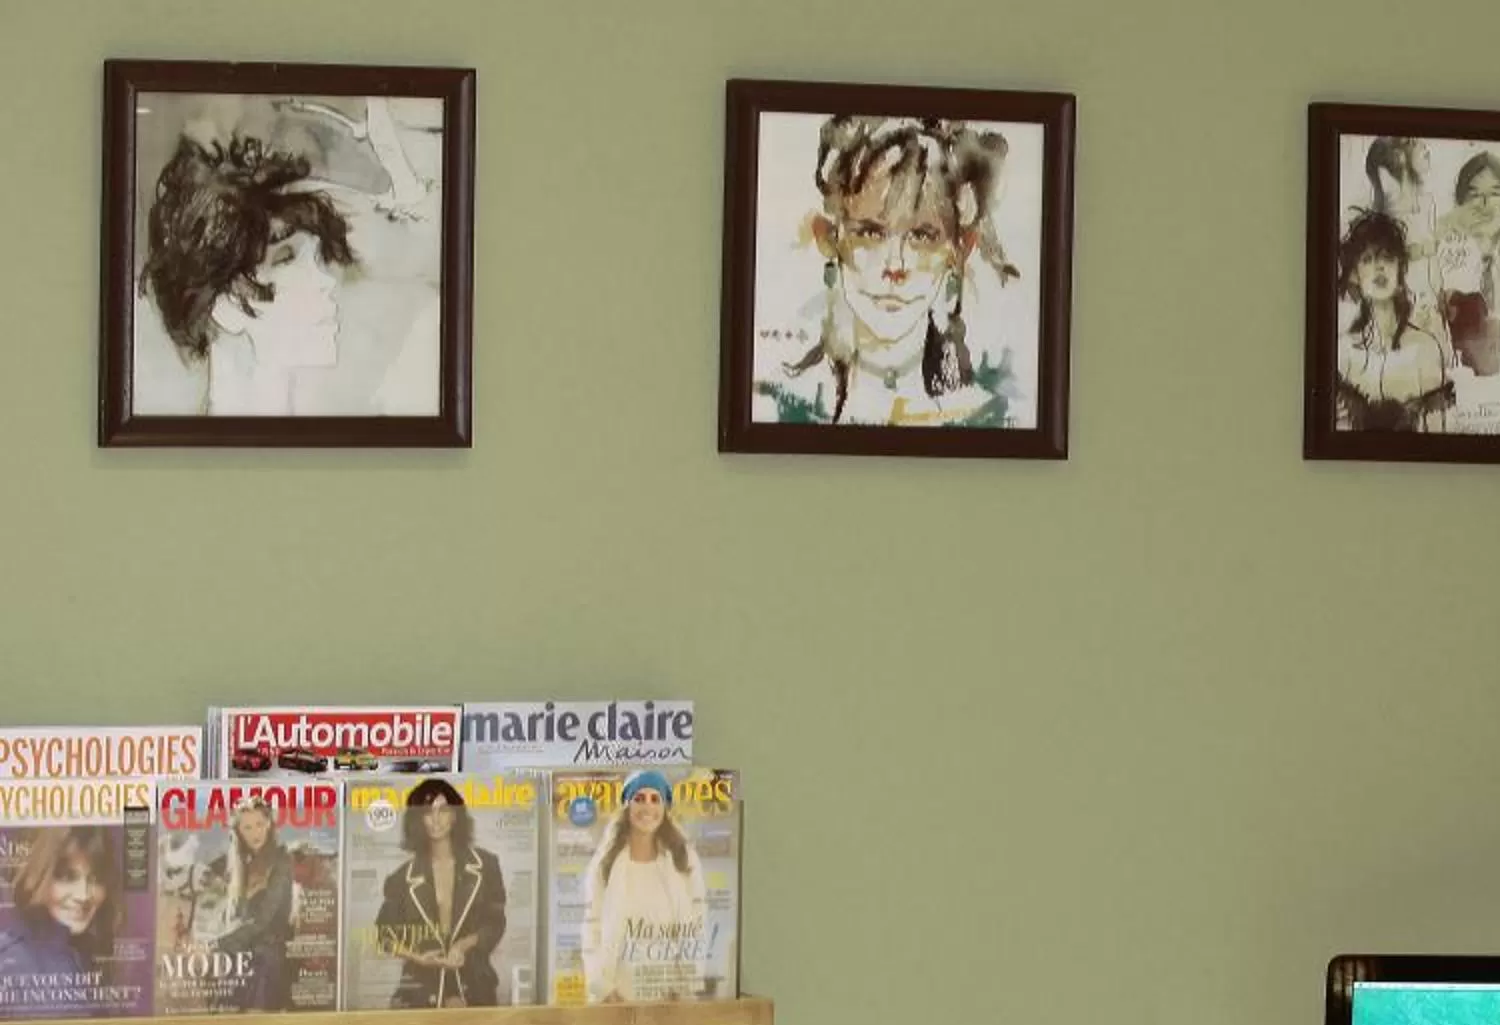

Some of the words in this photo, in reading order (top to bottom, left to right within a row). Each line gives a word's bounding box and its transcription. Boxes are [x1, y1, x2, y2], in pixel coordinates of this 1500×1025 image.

[238, 713, 453, 749] L'Automobile
[464, 701, 580, 742] marie
[588, 700, 693, 741] claire
[0, 735, 197, 778] PSYCHOLOGIES
[573, 738, 692, 764] Maison
[160, 951, 255, 978] MODE
